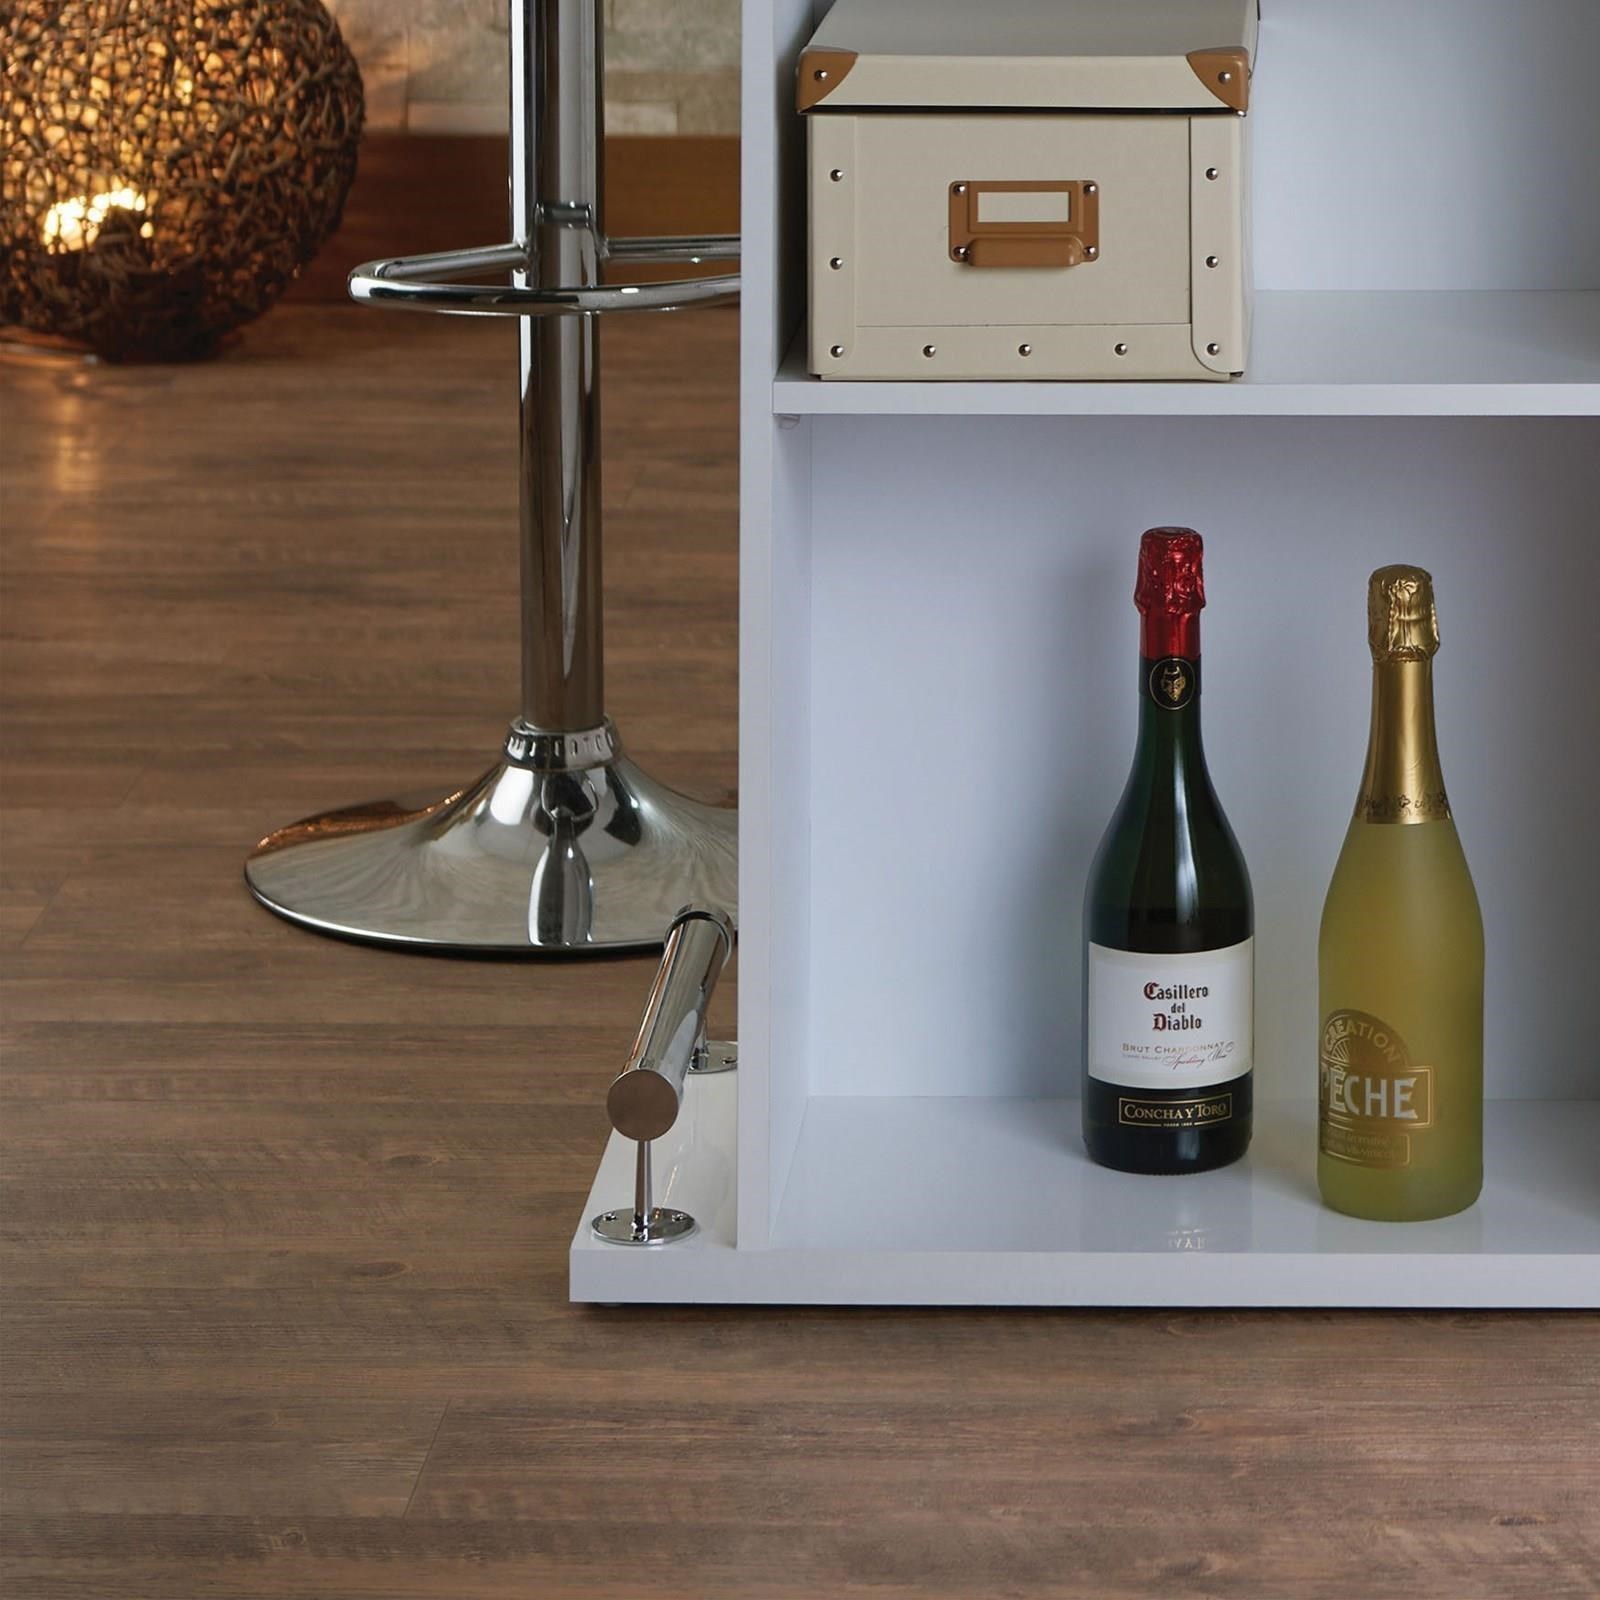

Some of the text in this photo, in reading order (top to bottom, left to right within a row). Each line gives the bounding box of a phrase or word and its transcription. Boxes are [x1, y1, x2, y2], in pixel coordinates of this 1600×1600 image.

[1143, 981, 1209, 1000] Casillero
[1170, 1002, 1186, 1014] del
[1152, 1013, 1202, 1031] Diablo
[1122, 1043, 1150, 1054] BRUT
[1123, 1102, 1227, 1120] CONCHA Y TORO
